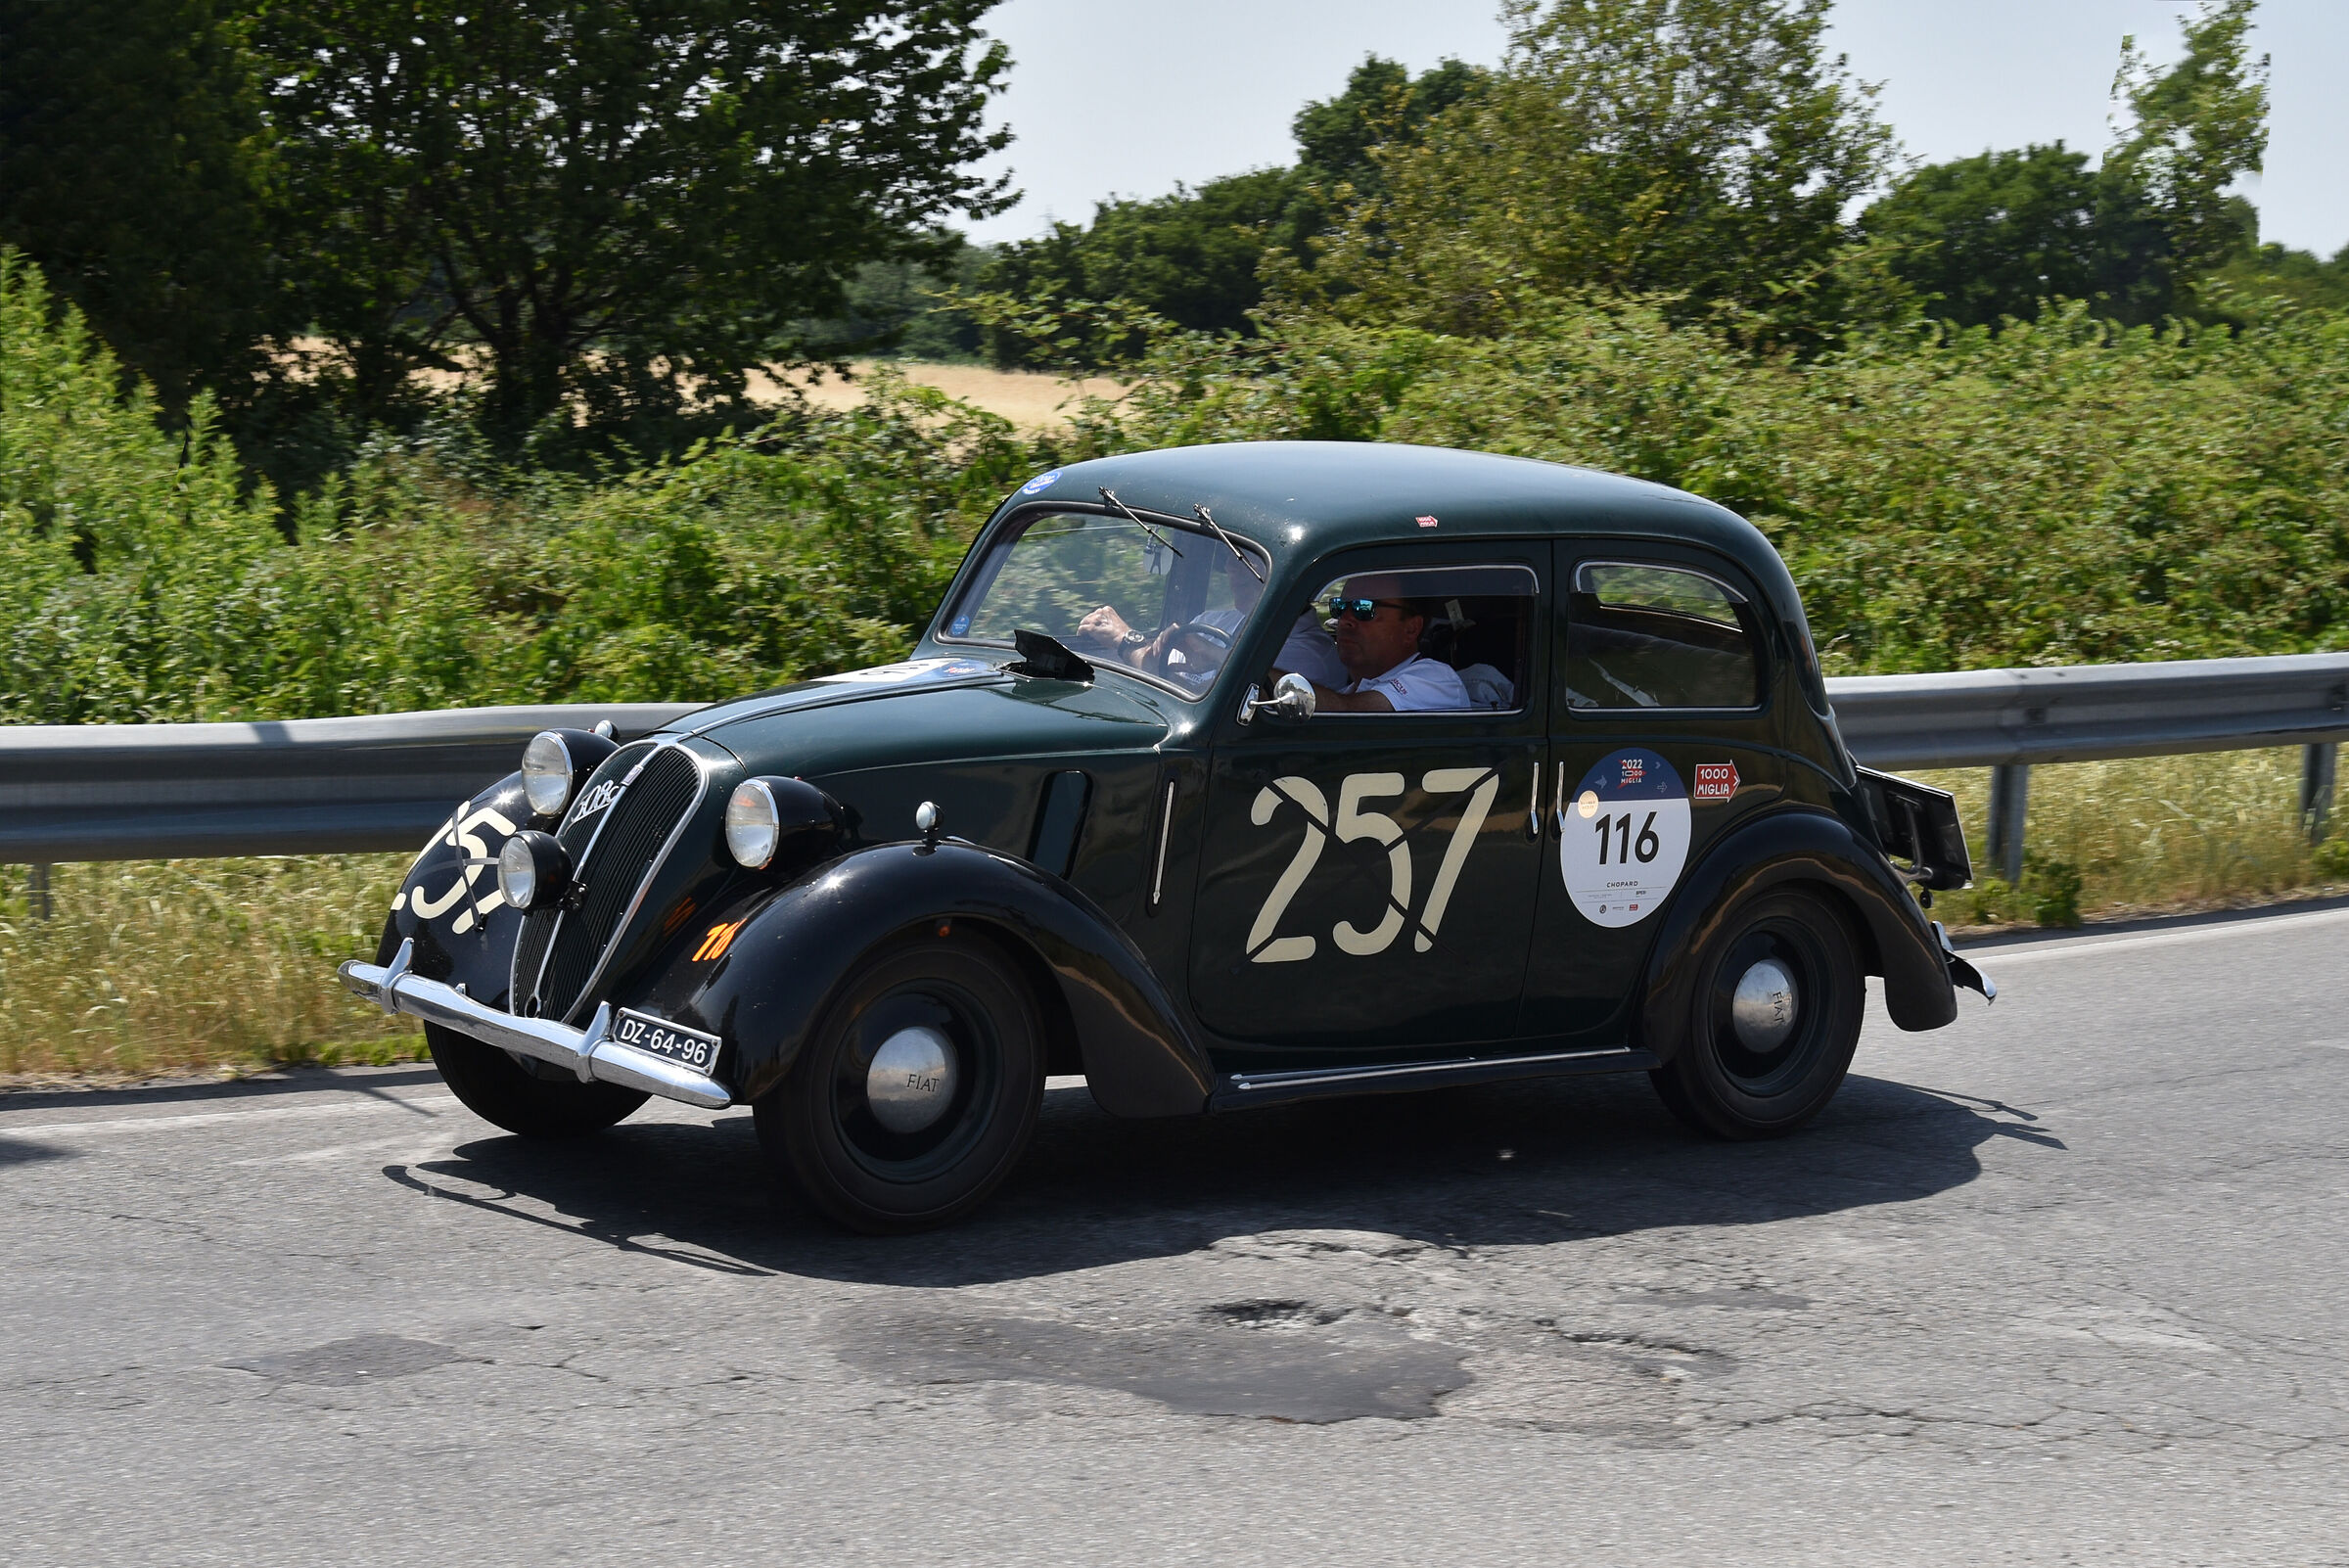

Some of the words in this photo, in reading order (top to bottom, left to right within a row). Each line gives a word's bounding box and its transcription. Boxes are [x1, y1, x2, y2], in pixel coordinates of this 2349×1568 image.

[1622, 759, 1642, 769] 2022
[1700, 768, 1728, 780] 1000
[1697, 783, 1729, 796] MIGLIA
[1595, 811, 1659, 865] 116
[1246, 767, 1499, 963] 257
[1772, 992, 1785, 1025] FIAT
[621, 1019, 709, 1065] DZ-64-96
[906, 1074, 940, 1092] FIAT
